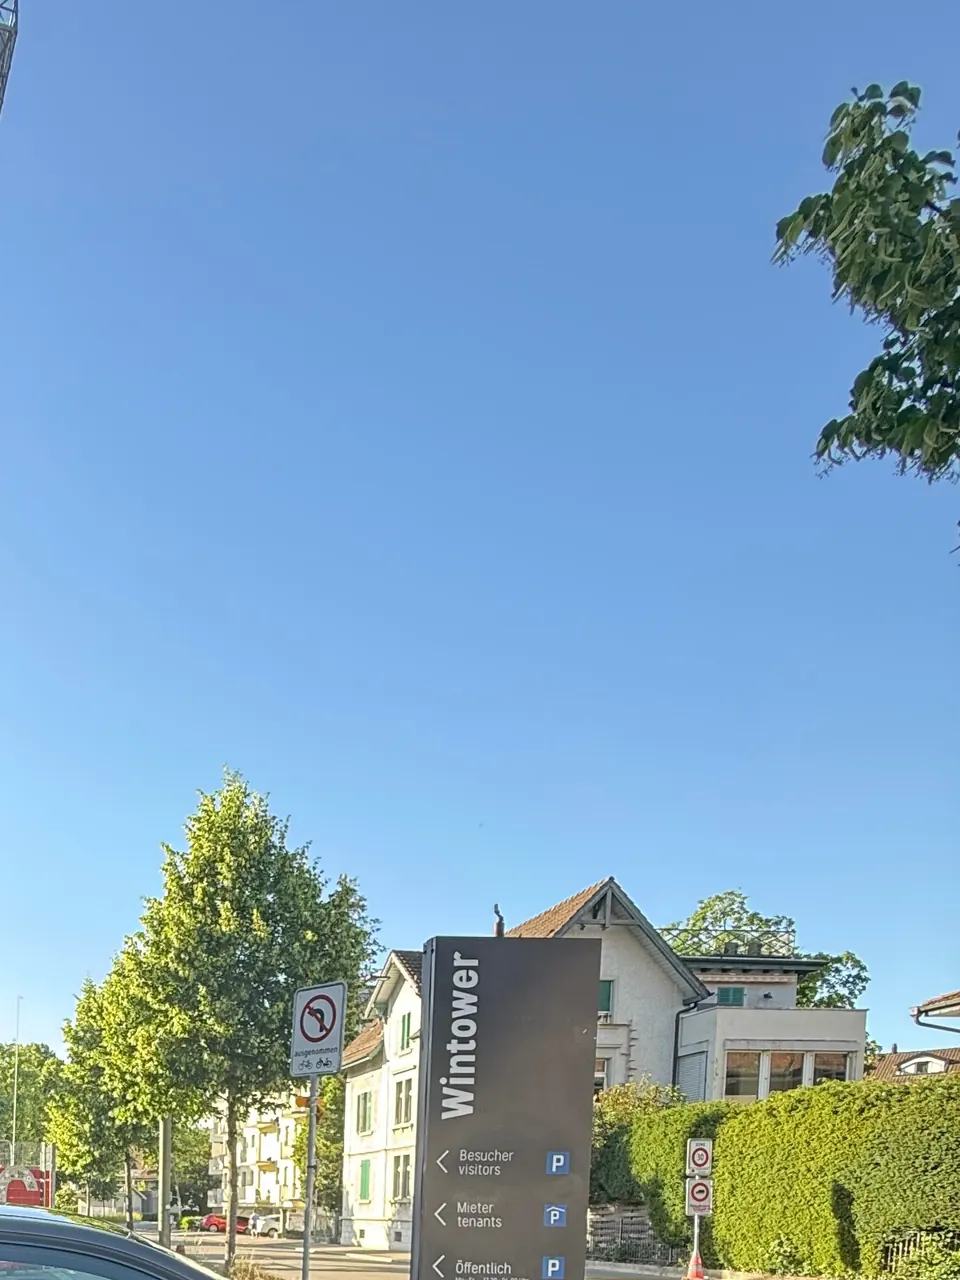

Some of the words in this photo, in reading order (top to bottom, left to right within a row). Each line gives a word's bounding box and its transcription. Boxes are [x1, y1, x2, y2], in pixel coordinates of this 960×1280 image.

[439, 951, 479, 1120] Wintower
[294, 1047, 338, 1058] ausgenommen
[459, 1149, 514, 1162] Besucher
[696, 1153, 704, 1161] 30
[551, 1155, 564, 1172] P
[458, 1164, 501, 1176] visitors
[456, 1202, 494, 1214] Mieter
[457, 1216, 502, 1228] tenants
[455, 1259, 512, 1275] Öffentlich
[548, 1259, 559, 1276] P
